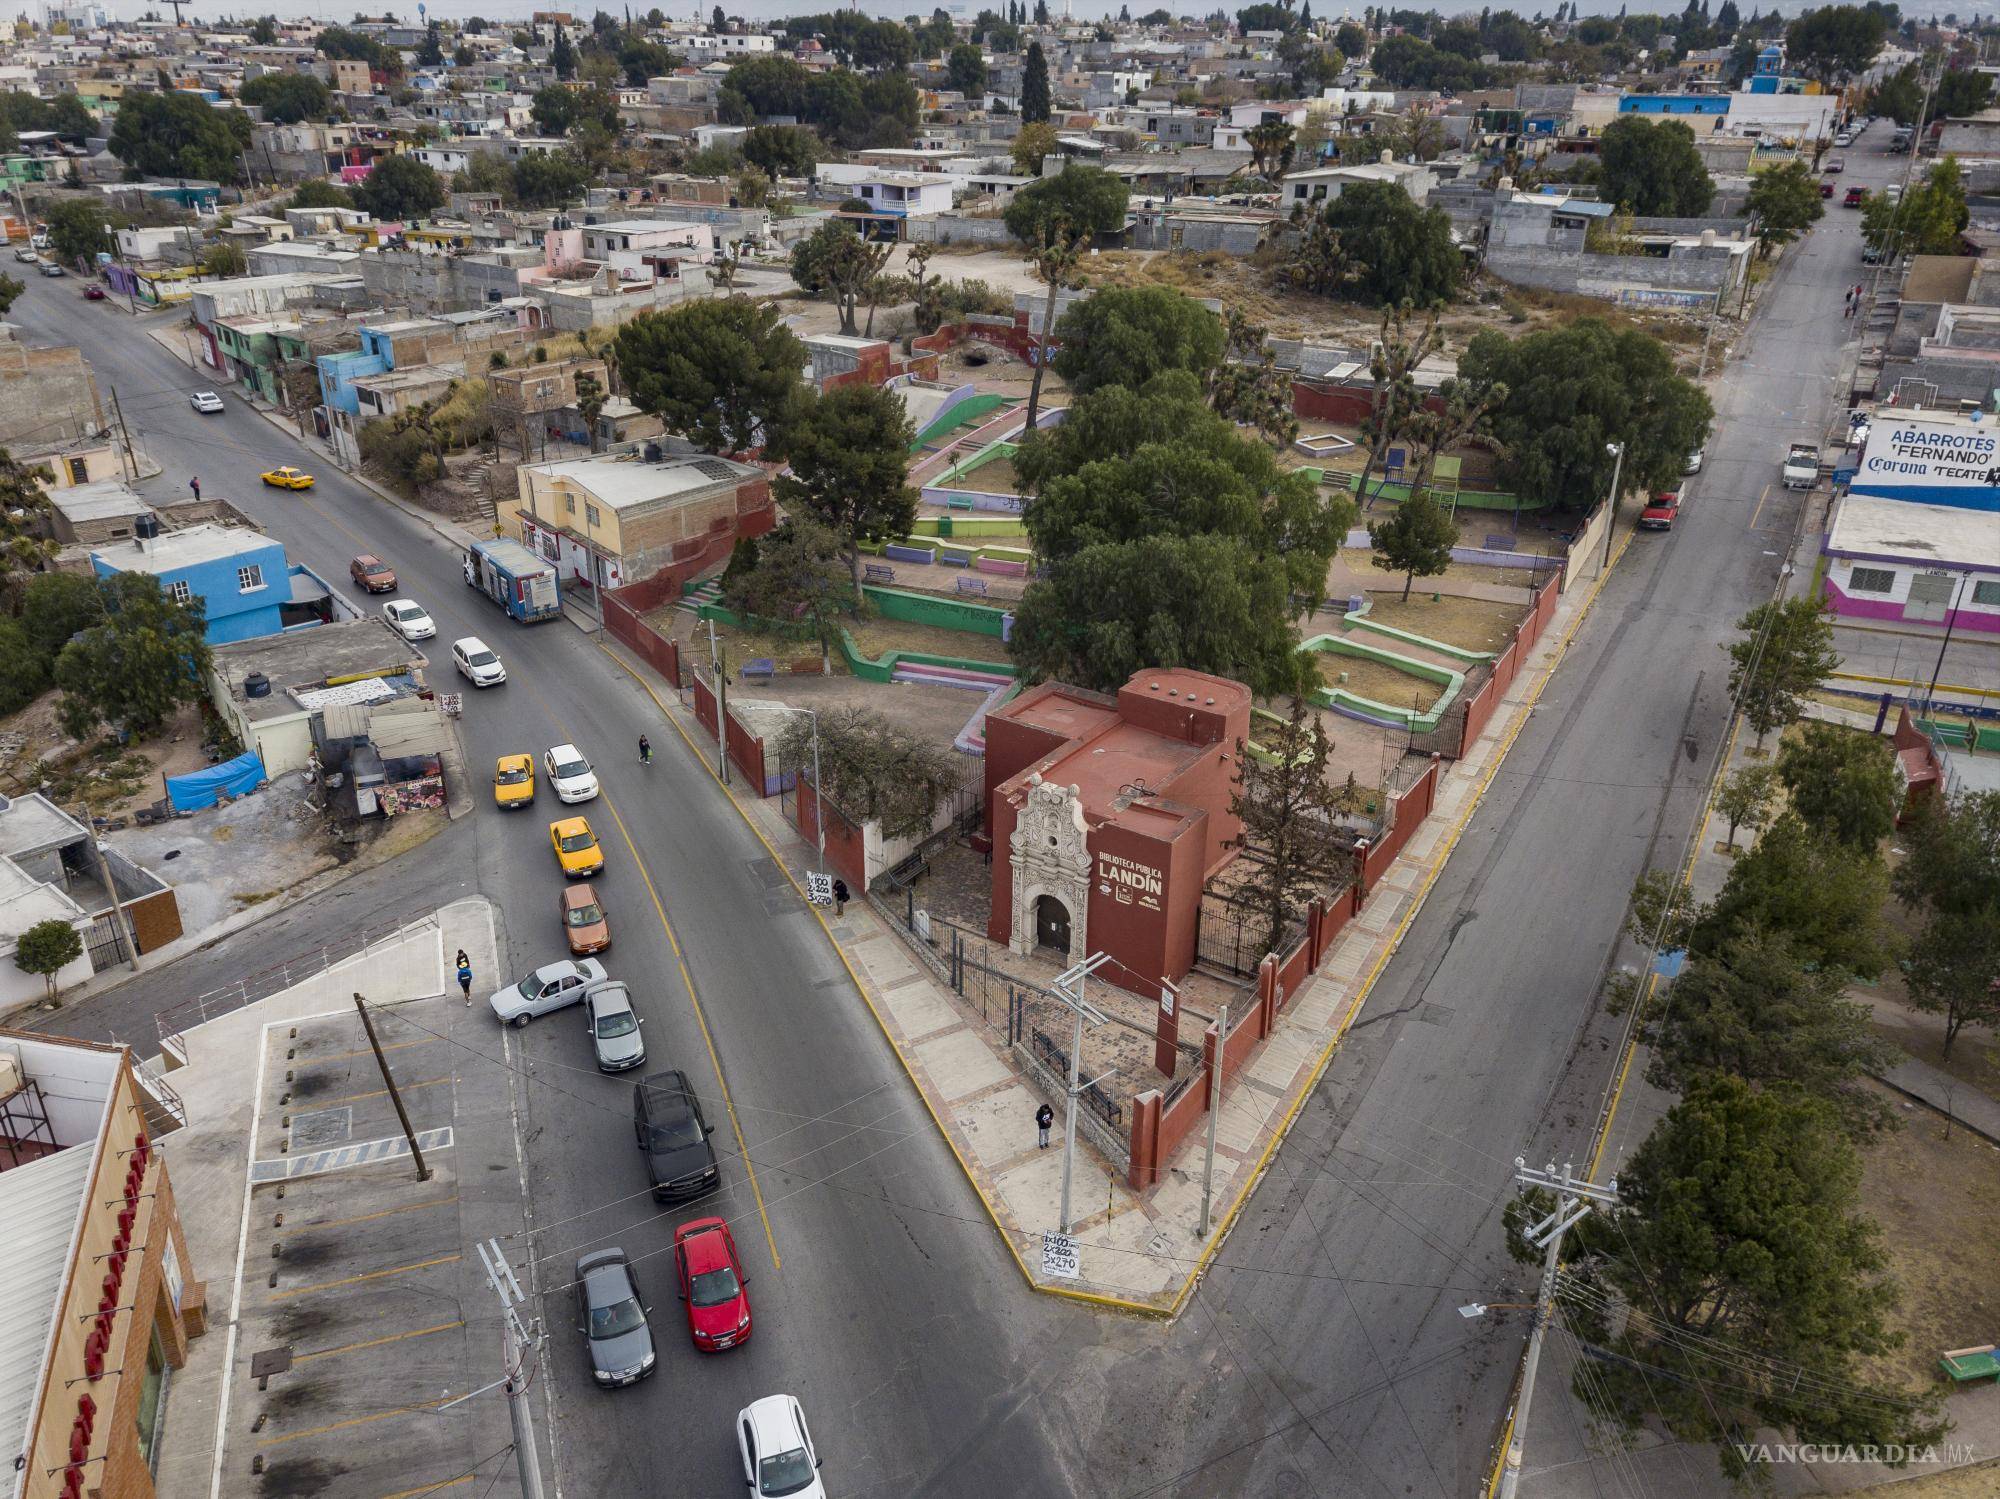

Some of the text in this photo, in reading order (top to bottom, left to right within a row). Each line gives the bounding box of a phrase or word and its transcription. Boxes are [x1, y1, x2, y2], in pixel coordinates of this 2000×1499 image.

[1891, 430, 1996, 452] ABARROTES
[1868, 456, 1987, 481] Corona TECATE
[1099, 851, 1162, 879] BIBLIOTECA PUBLICA
[1099, 862, 1162, 896] LANDÍN
